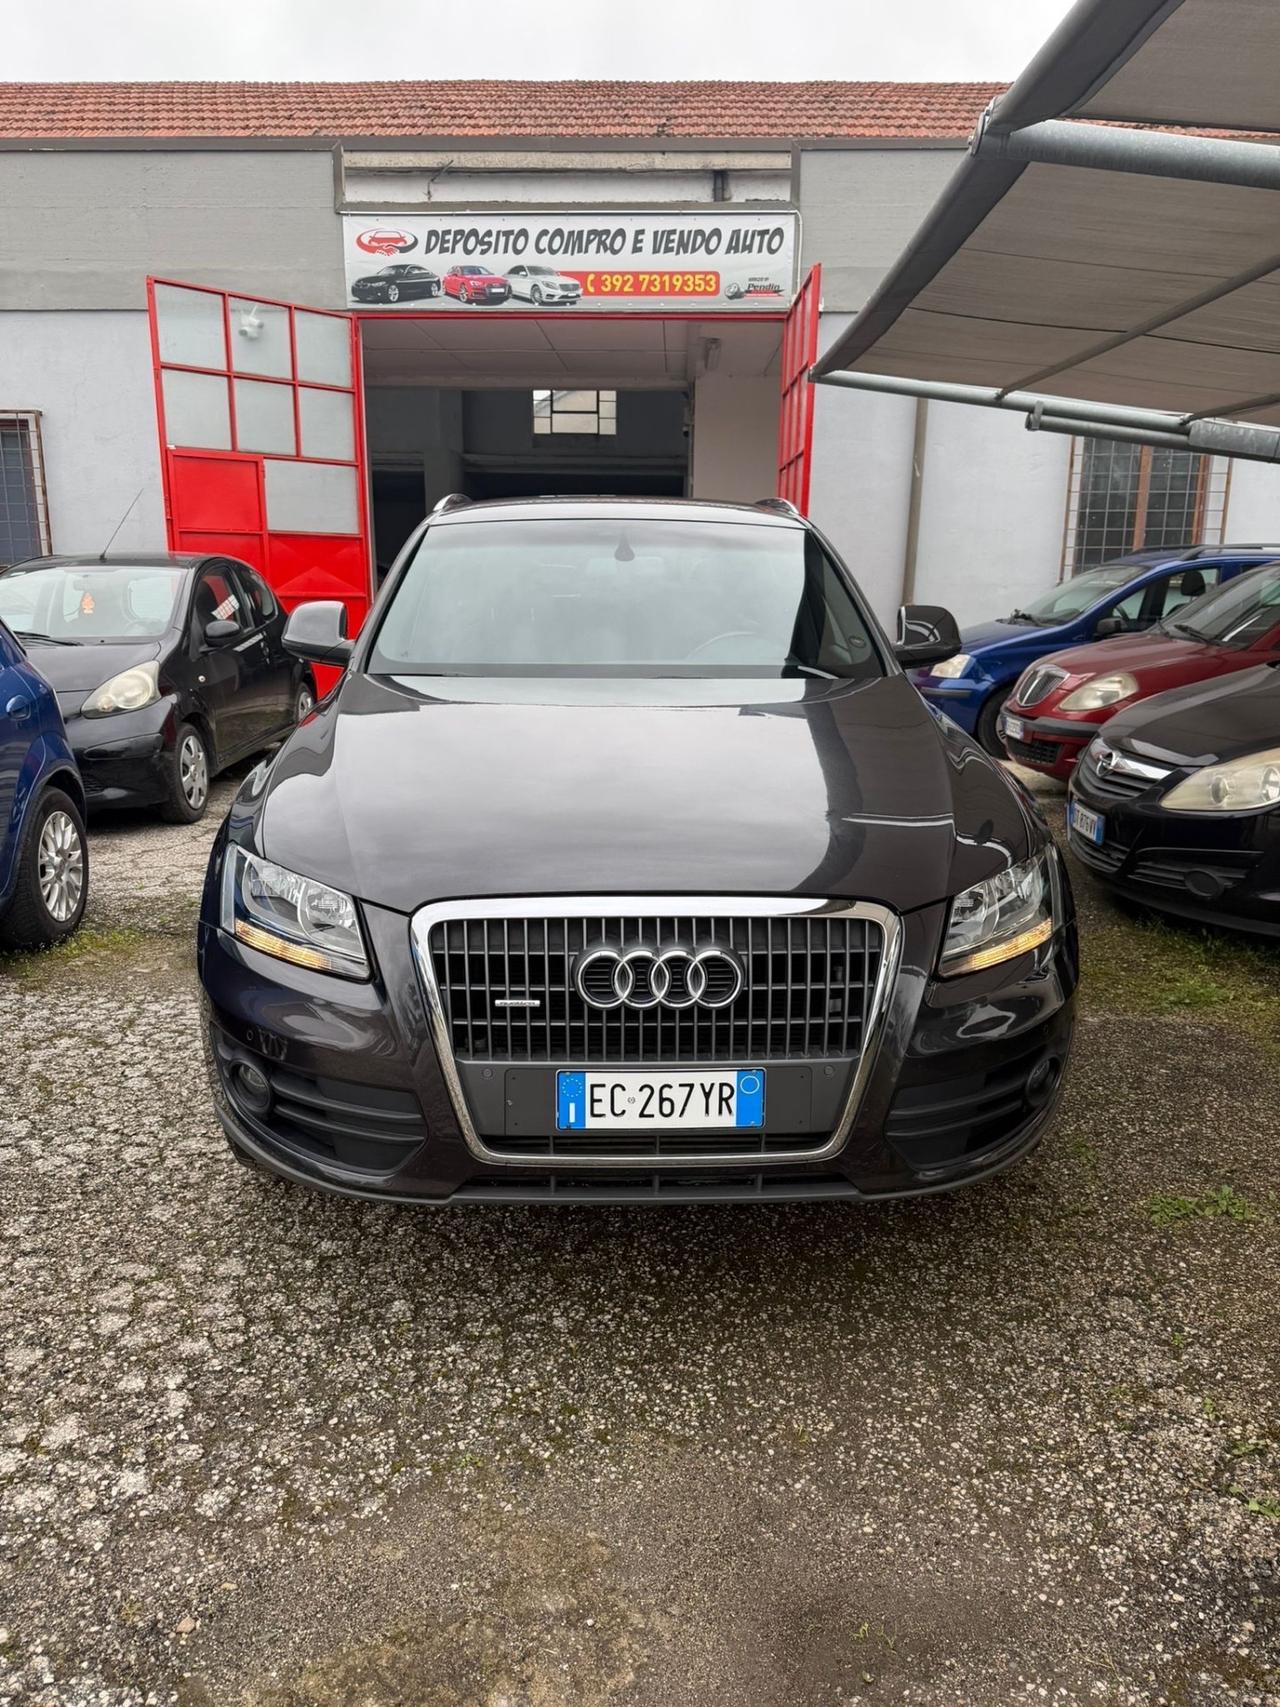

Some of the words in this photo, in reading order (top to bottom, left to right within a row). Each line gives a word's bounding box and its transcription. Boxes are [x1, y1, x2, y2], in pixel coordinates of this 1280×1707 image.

[425, 228, 528, 255] DEPOSITO
[535, 228, 626, 255] COMPRO
[631, 228, 645, 254] E
[652, 228, 721, 255] VENDO
[725, 227, 784, 255] AUTO
[601, 274, 634, 294] 392
[639, 273, 717, 294] 7319353
